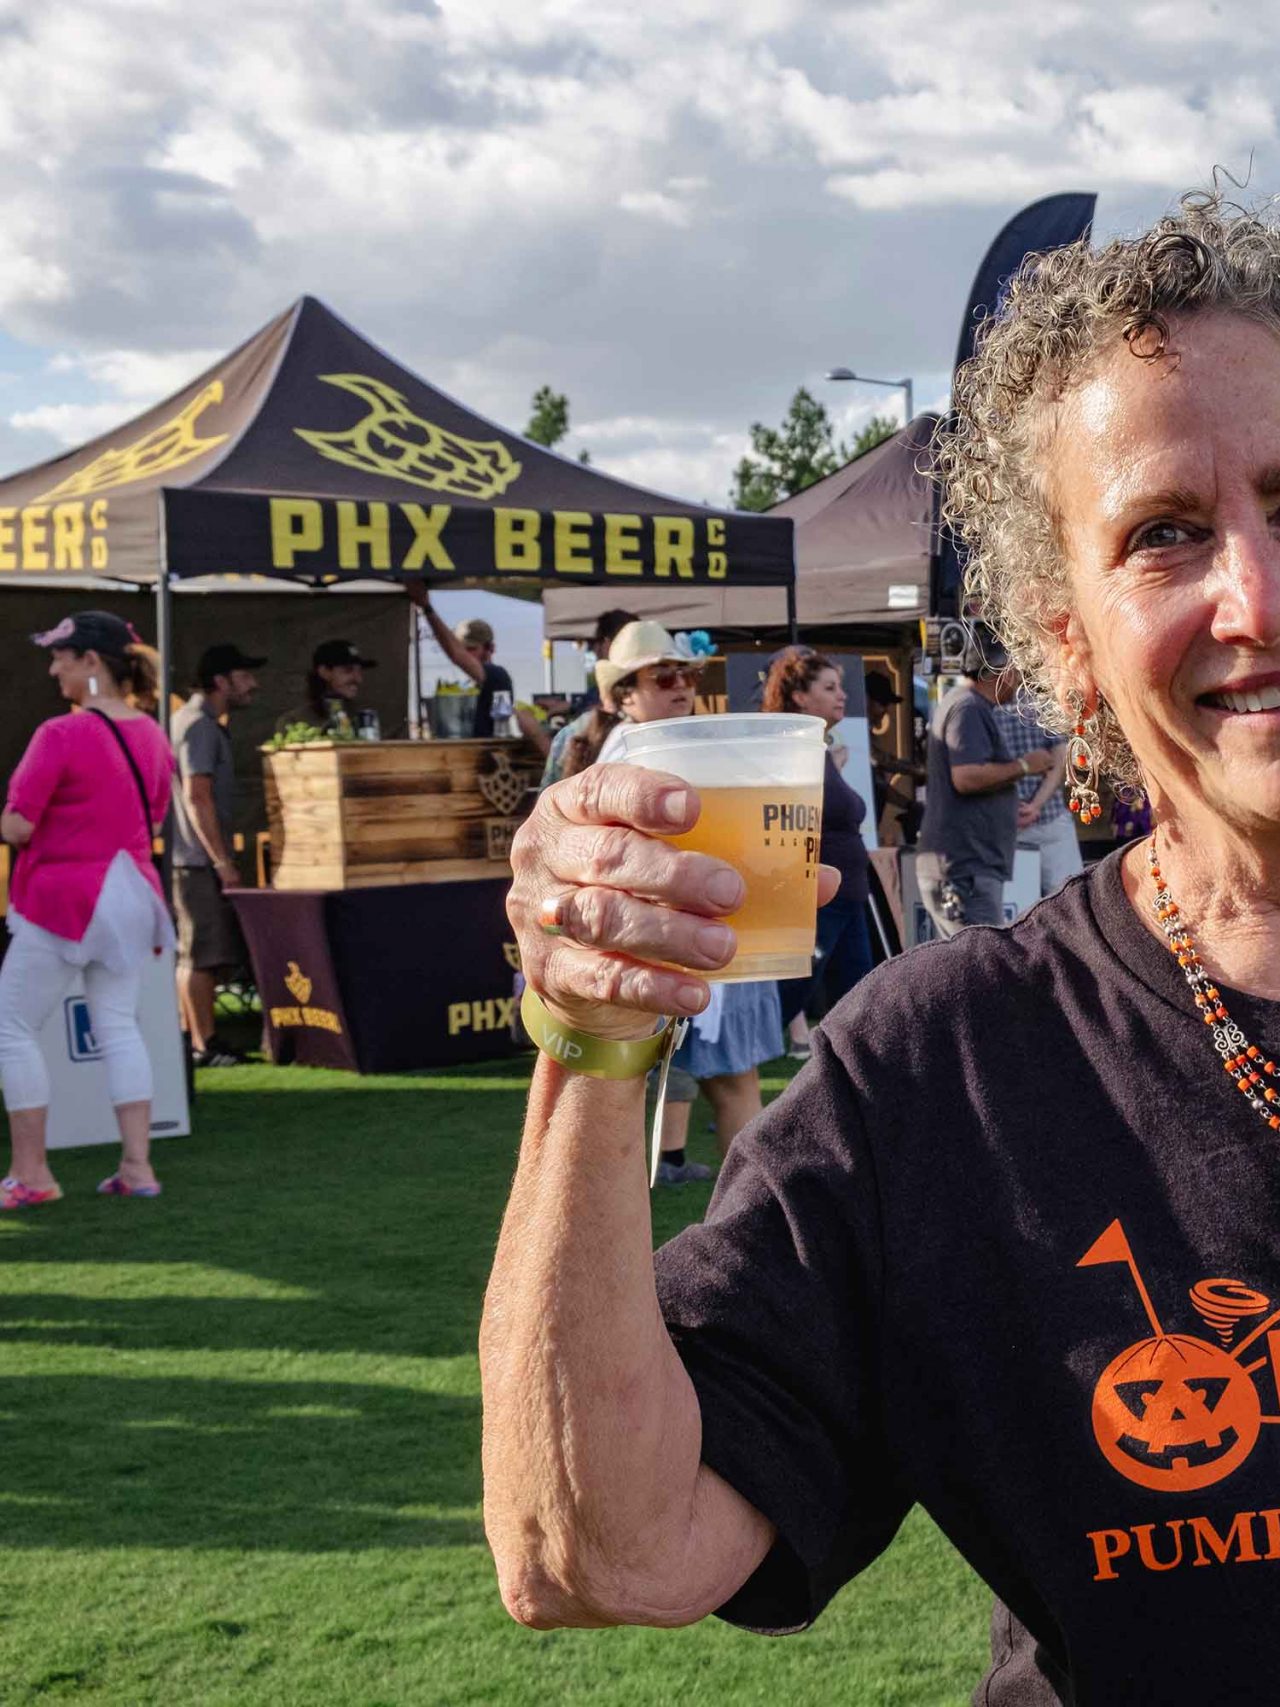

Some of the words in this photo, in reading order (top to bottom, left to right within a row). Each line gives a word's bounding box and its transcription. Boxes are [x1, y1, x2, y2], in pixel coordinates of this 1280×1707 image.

[270, 498, 455, 570] PHX
[493, 507, 694, 579] BEER
[449, 998, 514, 1035] PHX
[541, 1023, 583, 1059] VIP
